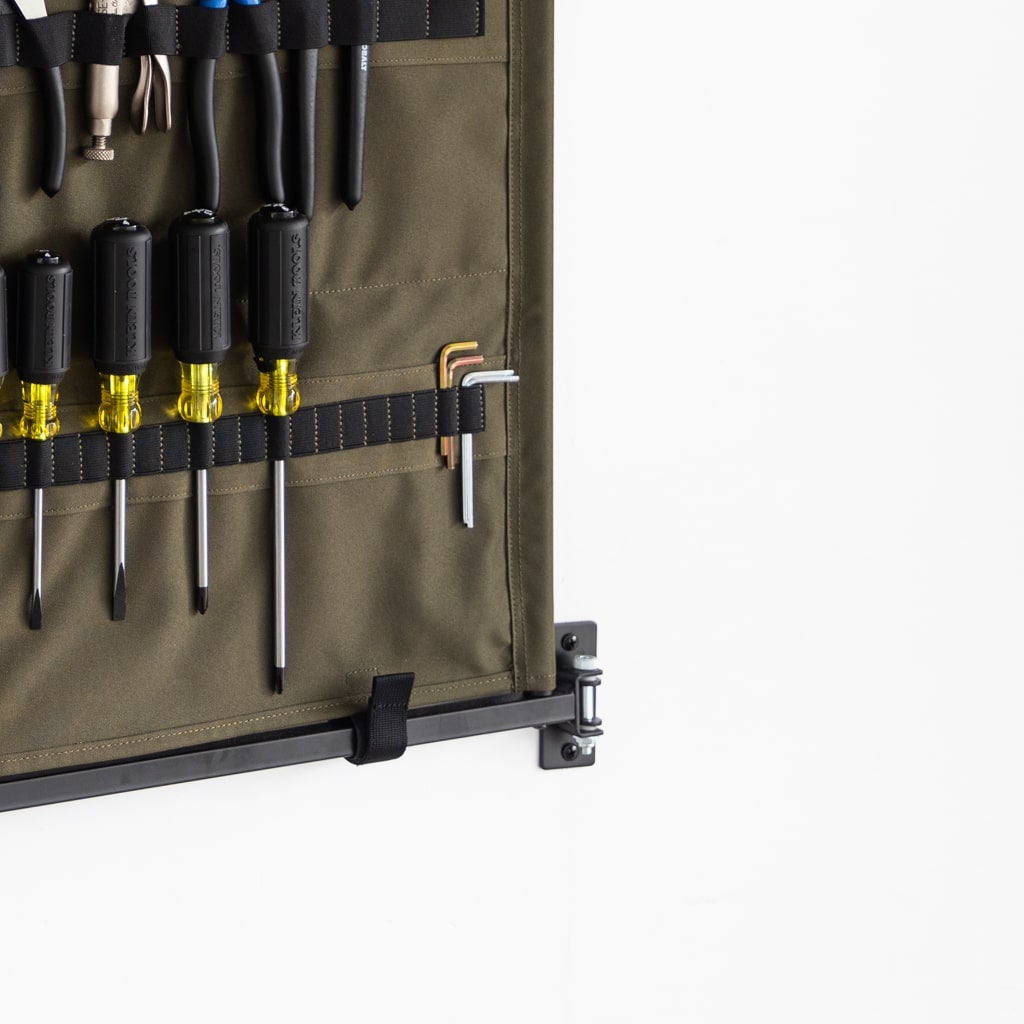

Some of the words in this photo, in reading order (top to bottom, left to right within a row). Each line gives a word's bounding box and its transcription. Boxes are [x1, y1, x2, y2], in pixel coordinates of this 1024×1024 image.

[126, 247, 138, 300] TOOLS
[290, 234, 301, 287] TOOLS
[126, 305, 137, 356] KLEIN
[290, 291, 301, 341] KLEIN
